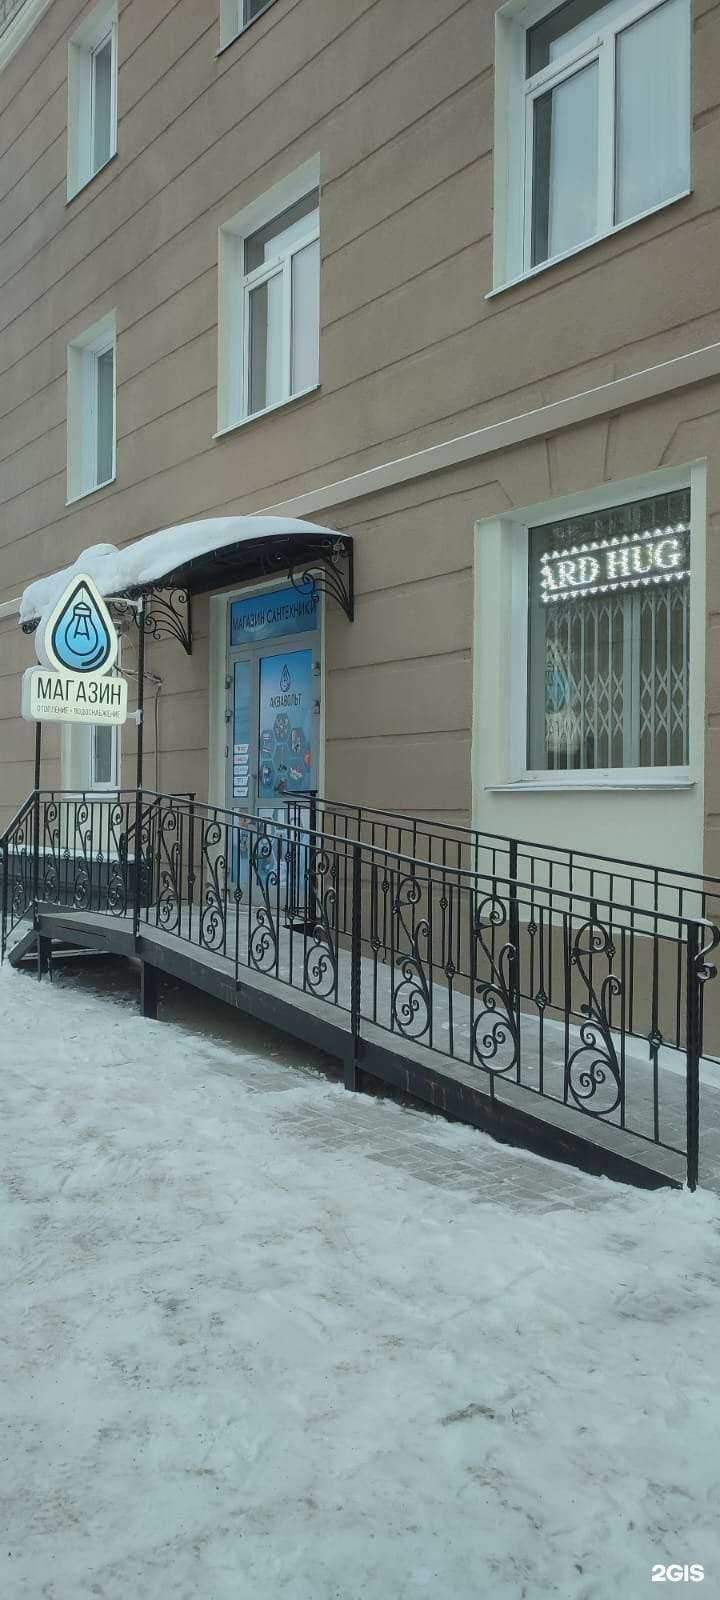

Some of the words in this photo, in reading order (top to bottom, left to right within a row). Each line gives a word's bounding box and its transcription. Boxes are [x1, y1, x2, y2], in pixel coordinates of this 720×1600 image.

[606, 539, 681, 579] HUG
[232, 609, 264, 631] МАГАЗИН
[37, 677, 121, 706] МАГАЗИН
